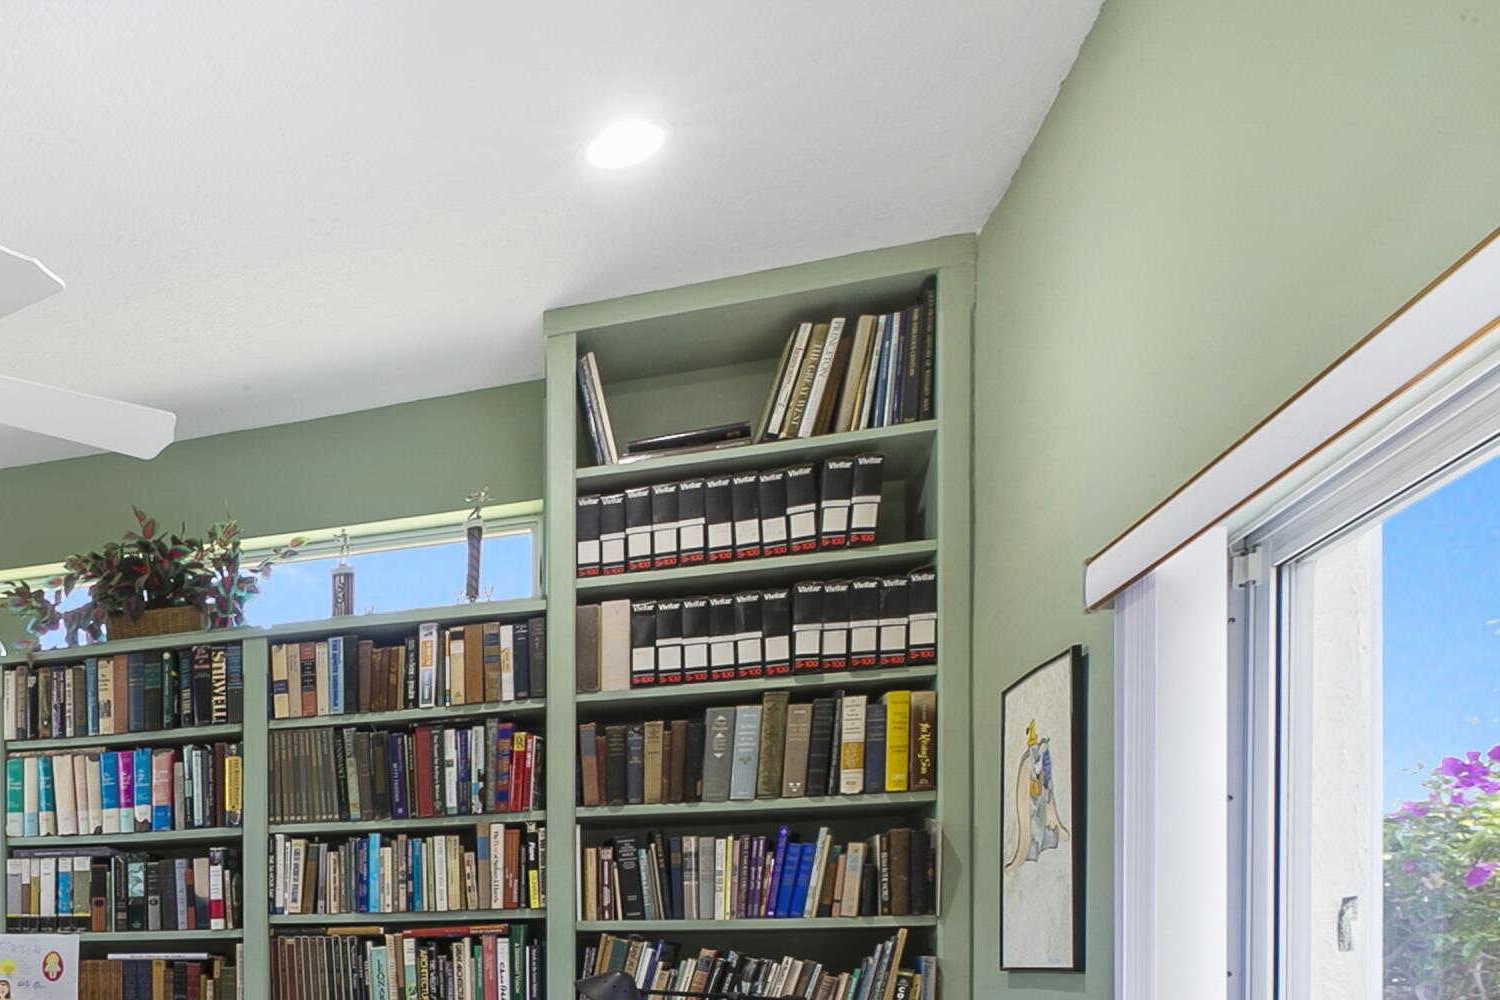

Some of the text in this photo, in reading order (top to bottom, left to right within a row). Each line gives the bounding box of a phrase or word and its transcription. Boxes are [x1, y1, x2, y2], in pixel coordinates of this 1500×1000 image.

[819, 320, 844, 378] PRINCETON
[790, 343, 823, 427] THE GREAT WEST
[858, 456, 883, 465] Vivitar
[828, 461, 852, 470] Vivitar
[788, 467, 812, 477] Vivitar
[733, 475, 756, 485] Vivitar
[759, 473, 783, 483] Vivitar
[680, 481, 702, 491] Vivitar
[707, 479, 730, 488] Vivitar
[627, 490, 649, 499] Vivitar
[653, 485, 676, 495] Vivitar
[578, 498, 599, 506] Vivitar
[602, 497, 623, 505] Vivitar
[821, 536, 845, 546] S-100
[850, 534, 875, 542] S-100
[764, 546, 787, 556] S-100
[791, 541, 816, 552] S-100
[709, 551, 732, 561] S-100
[736, 548, 759, 558] S-100
[655, 557, 676, 566] S-100
[681, 553, 703, 563] S-100
[629, 560, 650, 570] S-100
[911, 573, 935, 582] Vivitar
[853, 580, 878, 589] Vivitar
[883, 579, 908, 587] Vivitar
[797, 584, 821, 593] Vivitar
[825, 584, 849, 592] Vivitar
[736, 594, 759, 603] Vivitar
[764, 591, 787, 600] Vivitar
[658, 602, 680, 611] Vivitar
[684, 600, 706, 608] Vivitar
[709, 598, 732, 606] Vivitar
[633, 604, 655, 612] Vivitar
[910, 650, 935, 659] S-100
[795, 660, 819, 669] S-100
[822, 660, 846, 669] S-100
[851, 657, 876, 666] S-100
[880, 655, 905, 665] S-100
[739, 669, 762, 678] S-100
[766, 666, 790, 675] S-100
[632, 676, 655, 684] S-100
[659, 675, 681, 683] S-100
[685, 673, 708, 682] S-100
[711, 671, 735, 680] S-100
[211, 651, 227, 723] STILWELL
[916, 733, 932, 758] Rising
[920, 758, 931, 774] Sun
[528, 842, 536, 861] Piano
[455, 944, 464, 962] GREAT
[429, 972, 437, 993] WRIGHT
